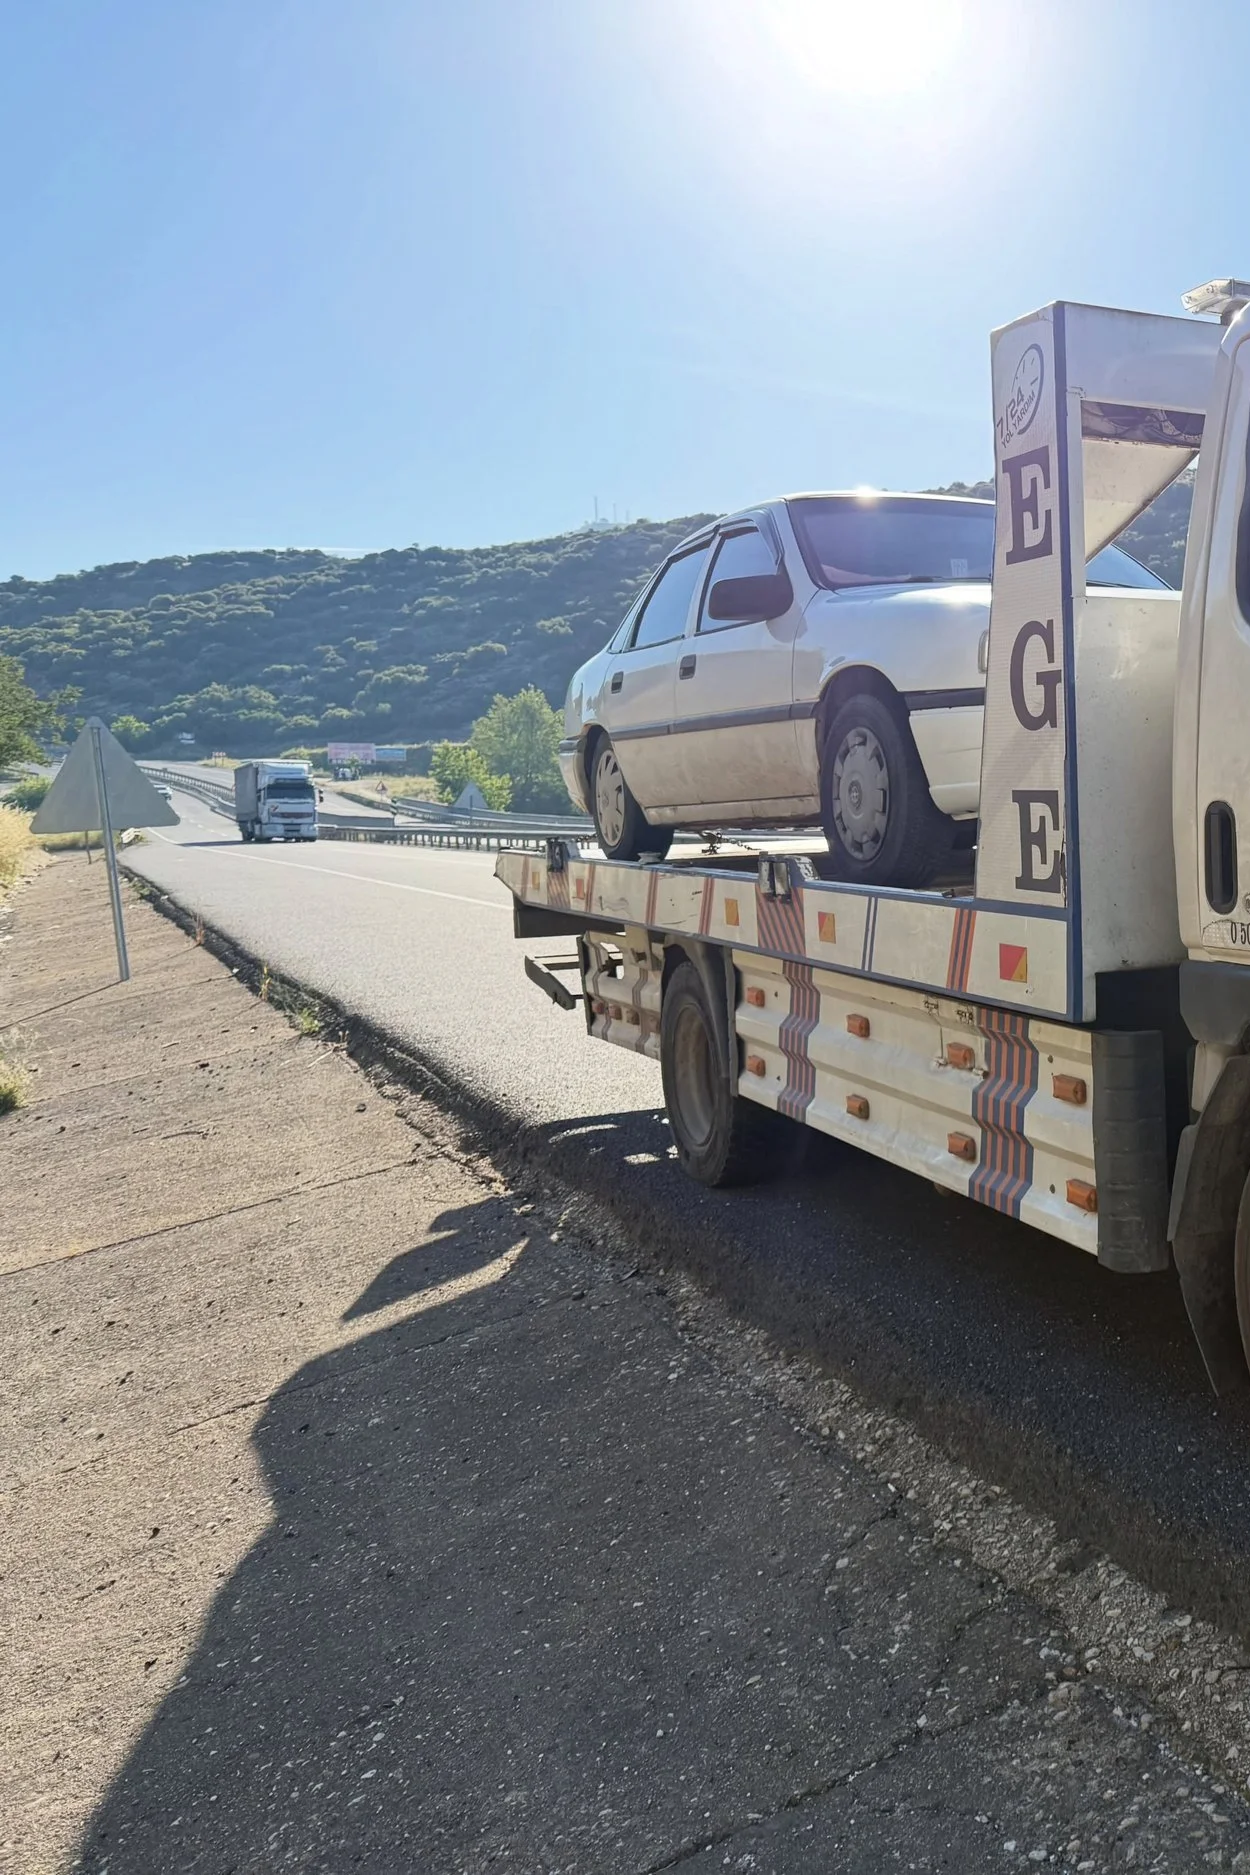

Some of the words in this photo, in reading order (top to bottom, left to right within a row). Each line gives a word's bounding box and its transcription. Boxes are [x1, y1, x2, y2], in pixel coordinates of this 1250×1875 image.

[997, 385, 1025, 439] 7/24
[1001, 429, 1014, 449] YOL
[1012, 389, 1036, 431] YARDIM
[1230, 921, 1238, 945] 0
